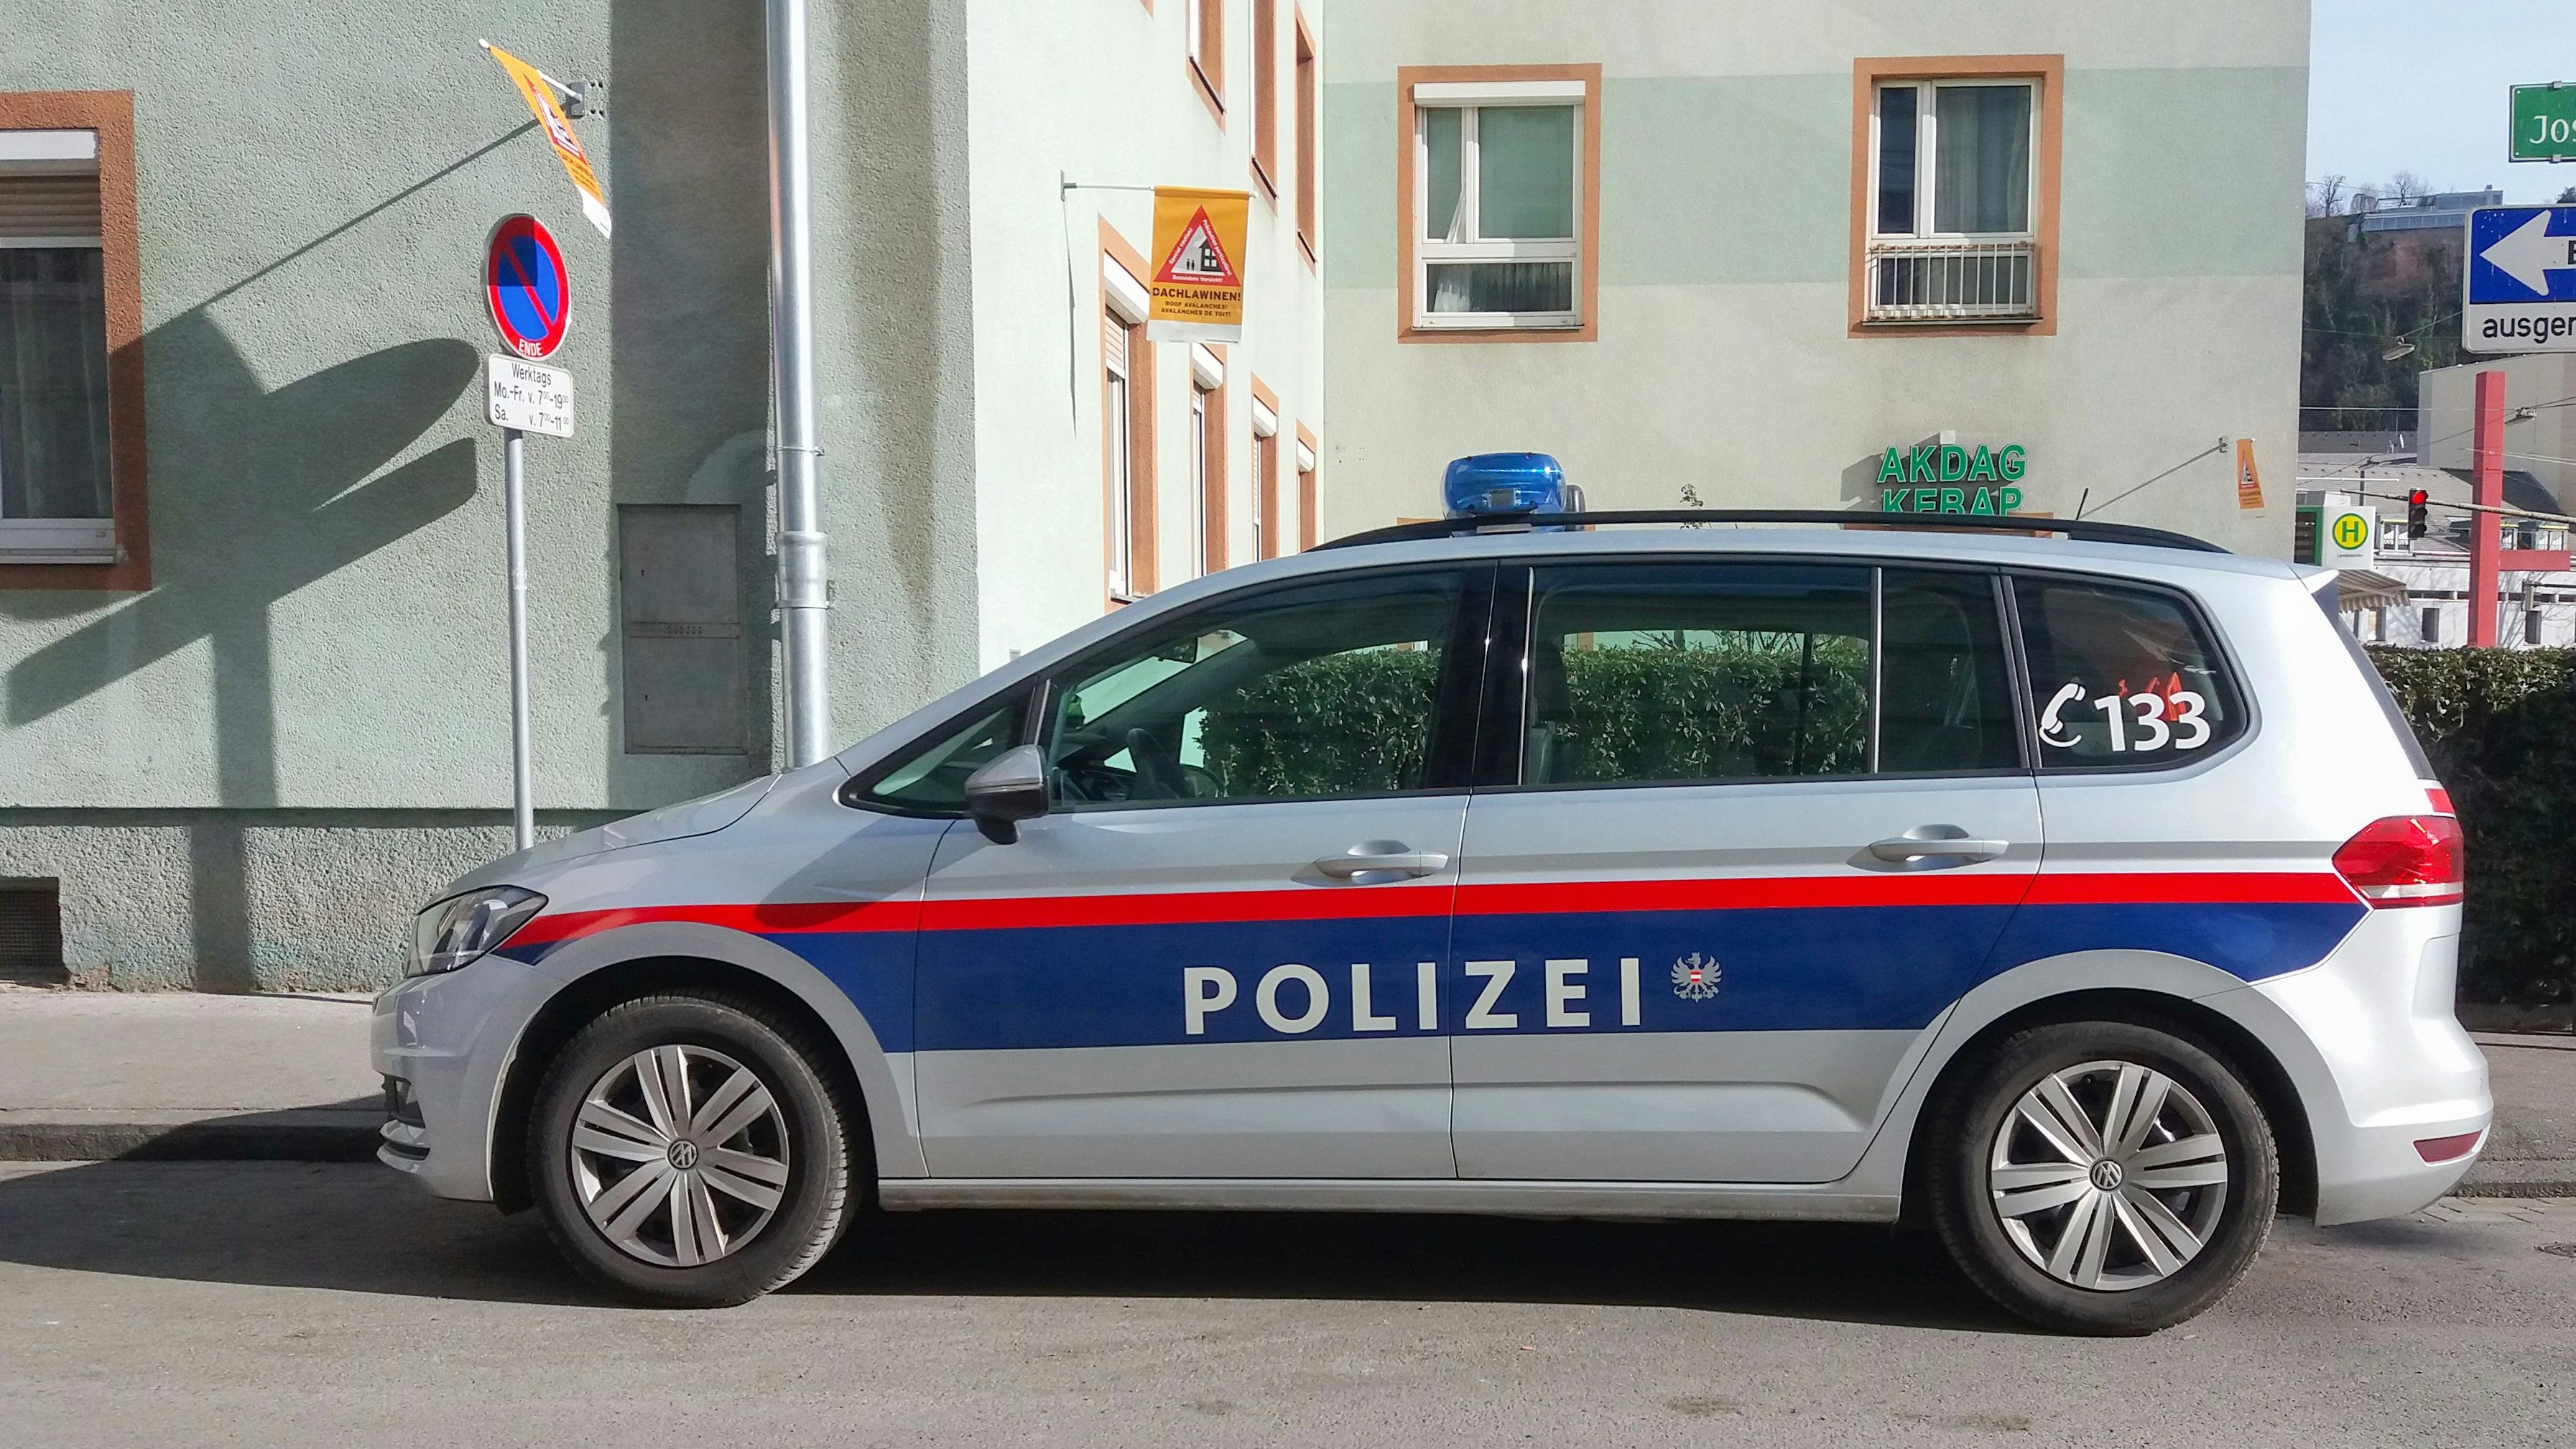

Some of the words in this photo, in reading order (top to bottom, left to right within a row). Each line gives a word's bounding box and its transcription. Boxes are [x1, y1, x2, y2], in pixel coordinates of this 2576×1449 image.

[1152, 287, 1241, 301] DACHLAWINEN!
[519, 338, 543, 356] ENDE
[511, 362, 551, 388] Werktags
[494, 381, 524, 402] Mo.-Fr.
[528, 392, 535, 404] v.
[494, 404, 509, 421] Sa.
[529, 415, 536, 426] v.
[1876, 443, 2027, 483] AKDAG
[1882, 486, 2024, 517] KEBAP
[2341, 521, 2359, 542] H
[2094, 691, 2211, 751] 133
[1184, 957, 1641, 1035] POLIZEI
